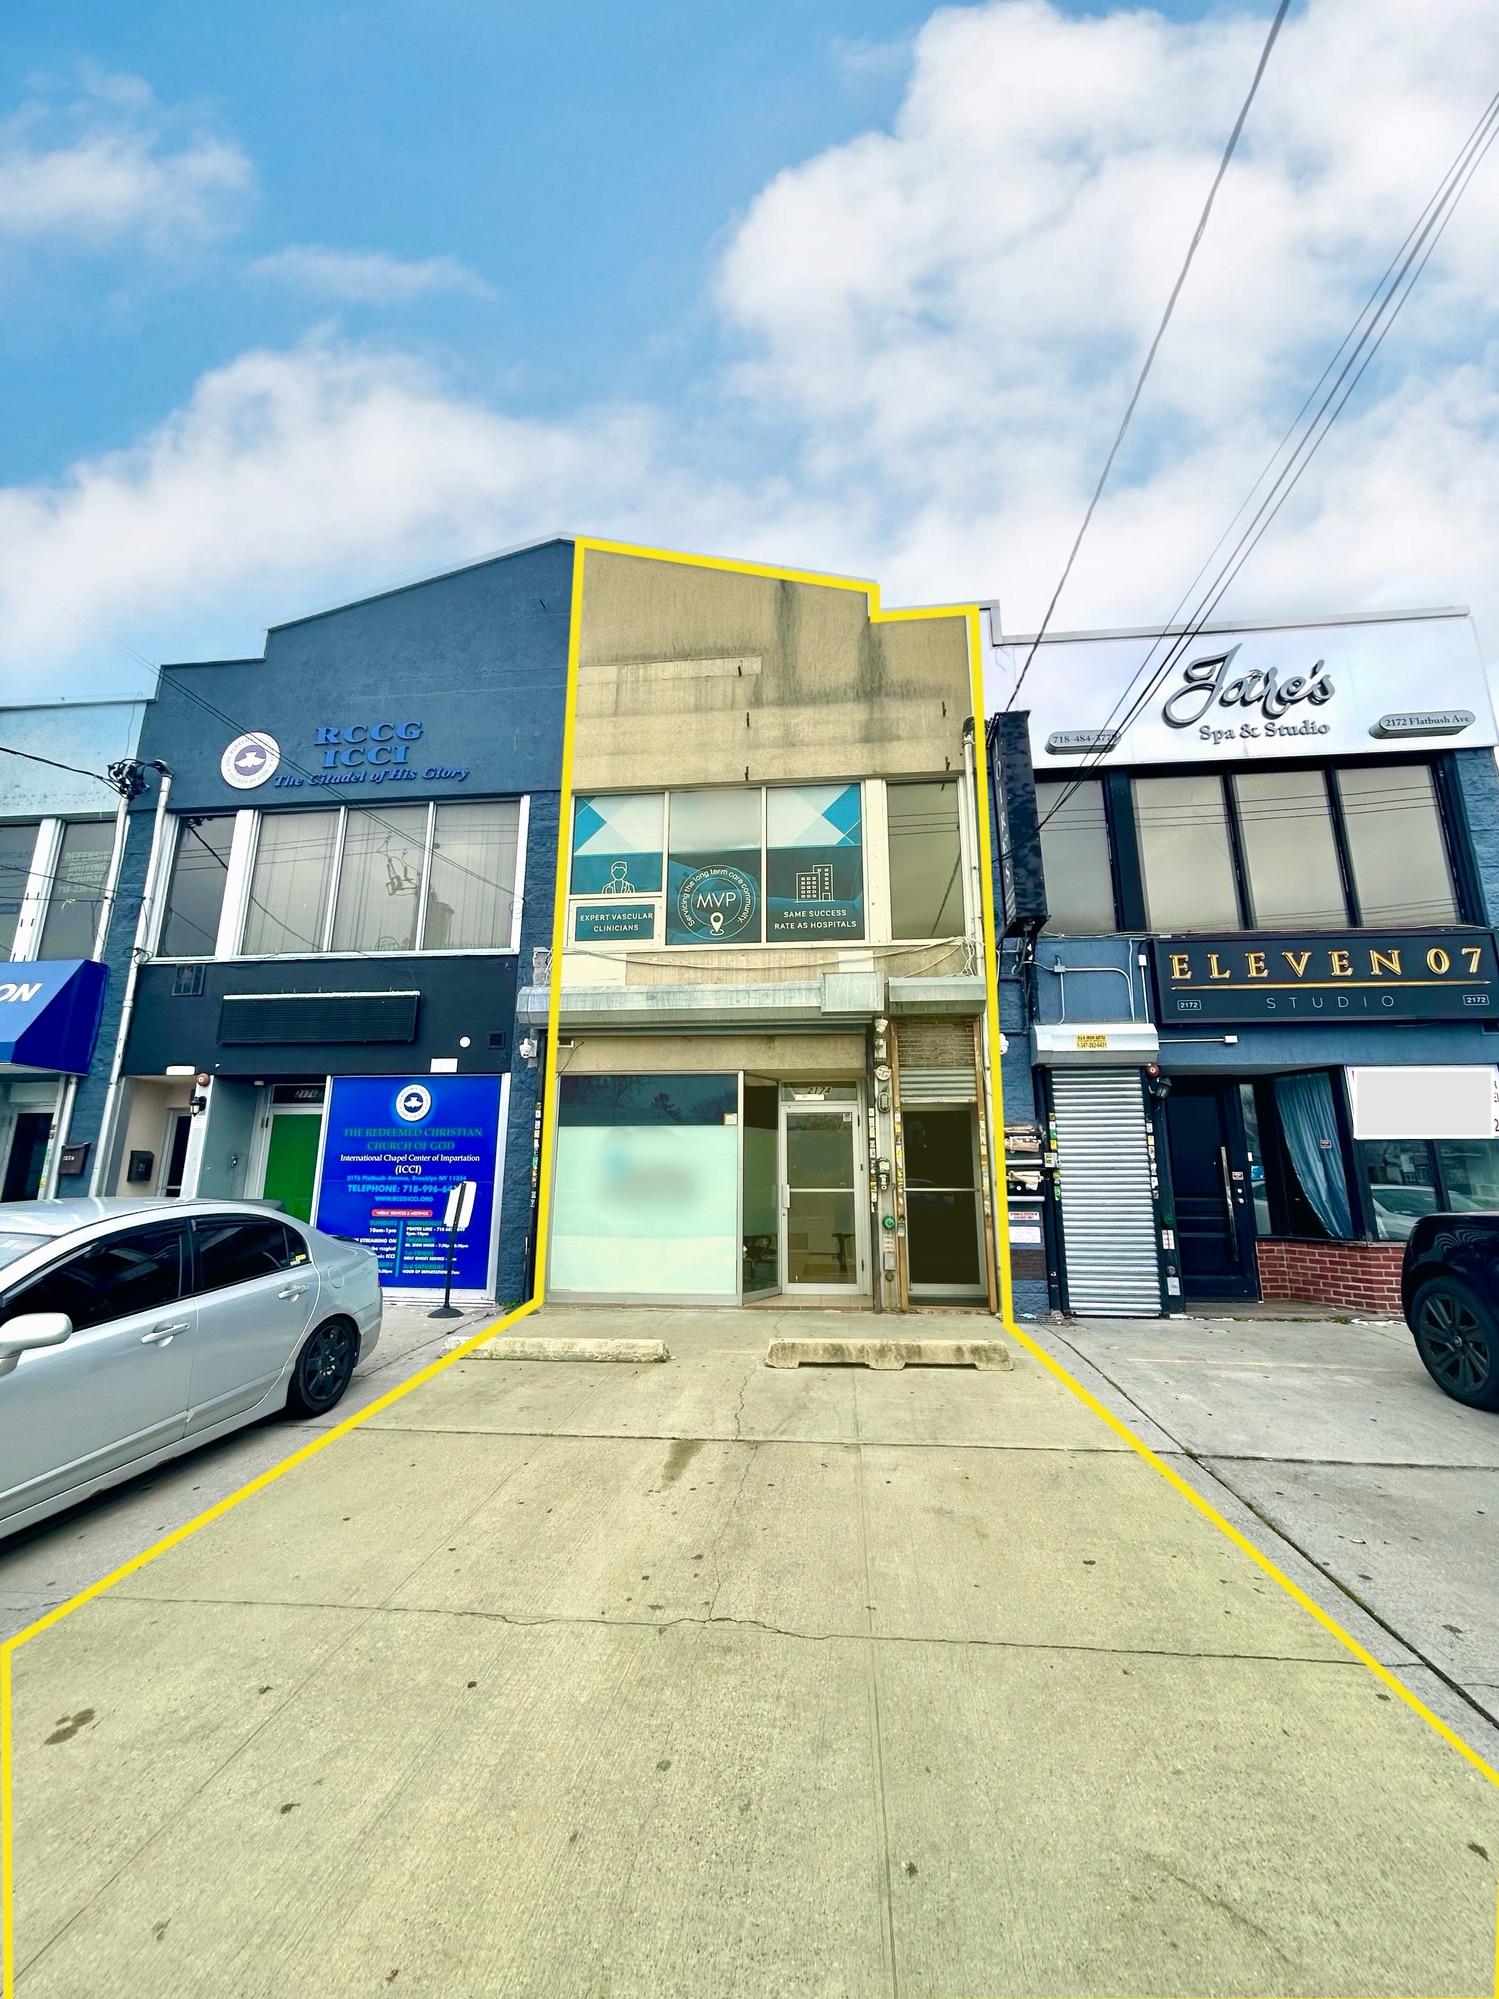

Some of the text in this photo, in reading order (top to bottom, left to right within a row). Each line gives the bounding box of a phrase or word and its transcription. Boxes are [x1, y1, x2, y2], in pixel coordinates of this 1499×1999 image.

[1385, 718, 1407, 726] 2172
[1409, 716, 1450, 725] Flatbush
[314, 722, 423, 745] RCCG
[1199, 720, 1330, 745] Spa & Studio
[322, 745, 410, 768] ICCI
[274, 766, 469, 788] The Citadel of His Glory
[67, 862, 107, 873] DRIVING
[66, 872, 104, 882] COURSE
[684, 880, 695, 893] the
[693, 870, 710, 883] long
[728, 871, 744, 884] care
[696, 892, 736, 909] MVP
[580, 912, 653, 922] EXPERT VASCULAR
[783, 909, 847, 918] SAME SUCCESS
[593, 924, 639, 932] CLINICIANS
[774, 922, 795, 930] RATE
[810, 920, 857, 929] HOSPITALS
[1169, 947, 1483, 980] ELEVEN 07
[1179, 1001, 1199, 1009] 2172
[1266, 995, 1395, 1009] STUDIO
[1465, 996, 1486, 1004] 2172
[807, 1086, 832, 1095] 2174
[343, 1127, 482, 1137] THE REDEEMED CHRISTIAN
[367, 1141, 455, 1150] CHURCH OF GOD
[340, 1154, 480, 1163] International Chapel Center of Impartation
[395, 1164, 422, 1175] (ICCI)
[348, 1184, 400, 1193] TELEPHONE:
